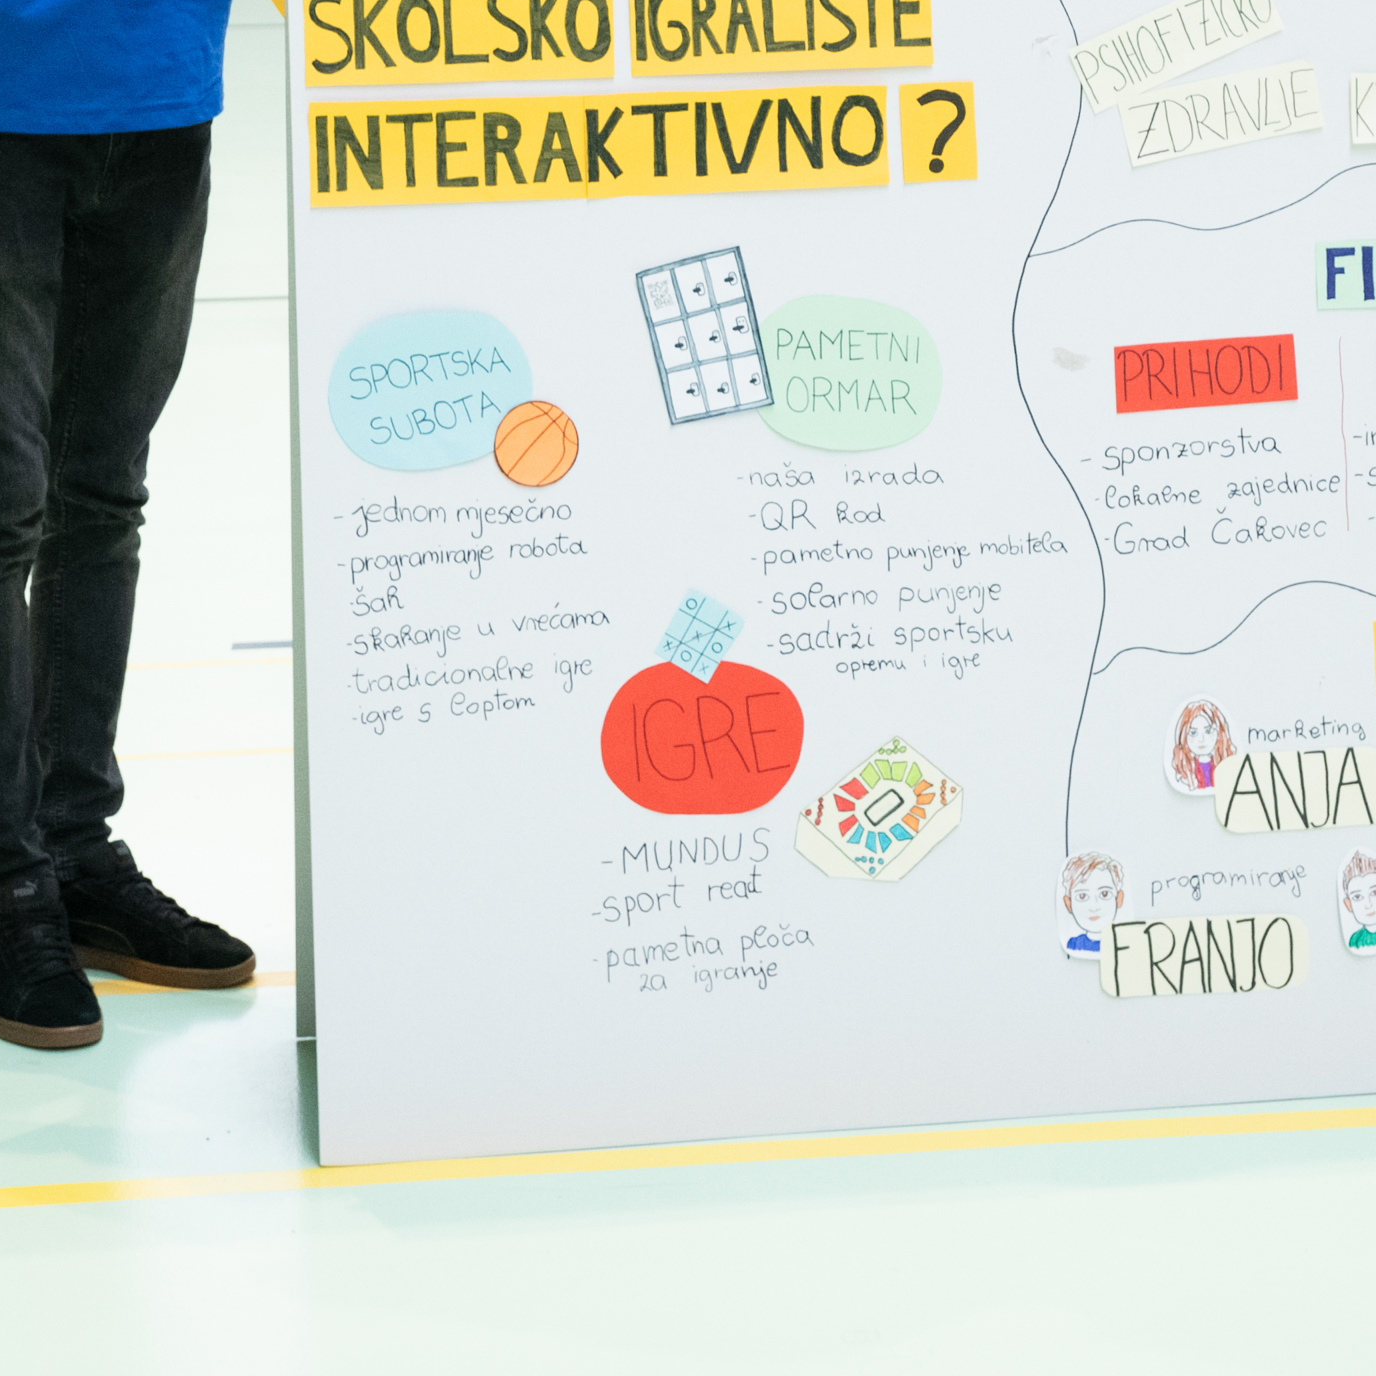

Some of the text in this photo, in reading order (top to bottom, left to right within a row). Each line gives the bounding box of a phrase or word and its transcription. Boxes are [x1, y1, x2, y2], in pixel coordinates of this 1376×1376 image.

[1127, 68, 1319, 159] ZDRAVLJE
[315, 94, 884, 194] INTERAKTIVNO
[776, 328, 920, 364] PAMETNI
[349, 346, 511, 400] SPORTSKA
[1116, 343, 1285, 403] PRIHODI
[786, 376, 917, 415] ORMAR
[369, 391, 501, 444] SUBOTA
[845, 462, 944, 486] izrada
[1227, 472, 1341, 507] zajednice
[457, 498, 572, 539] mjesečno
[836, 501, 886, 525] kod
[1211, 506, 1327, 544] Čakovec
[510, 533, 588, 558] robota
[887, 538, 971, 572] punjenje
[980, 531, 1068, 557] mobitela
[899, 582, 1002, 614] punjenje
[477, 622, 495, 636] u
[894, 617, 1013, 652] sportsku
[554, 653, 593, 694] igre
[836, 656, 906, 680] opremu
[942, 652, 981, 679] igre
[418, 702, 432, 723] s
[450, 688, 536, 721] loptom
[632, 691, 791, 782] IGRE
[1247, 716, 1366, 743] marketing
[1224, 747, 1374, 830] ANJA
[1151, 864, 1307, 907] programiranje
[741, 923, 815, 962] ploča
[1111, 916, 1294, 996] FRANJO
[640, 960, 778, 993] za igranje
